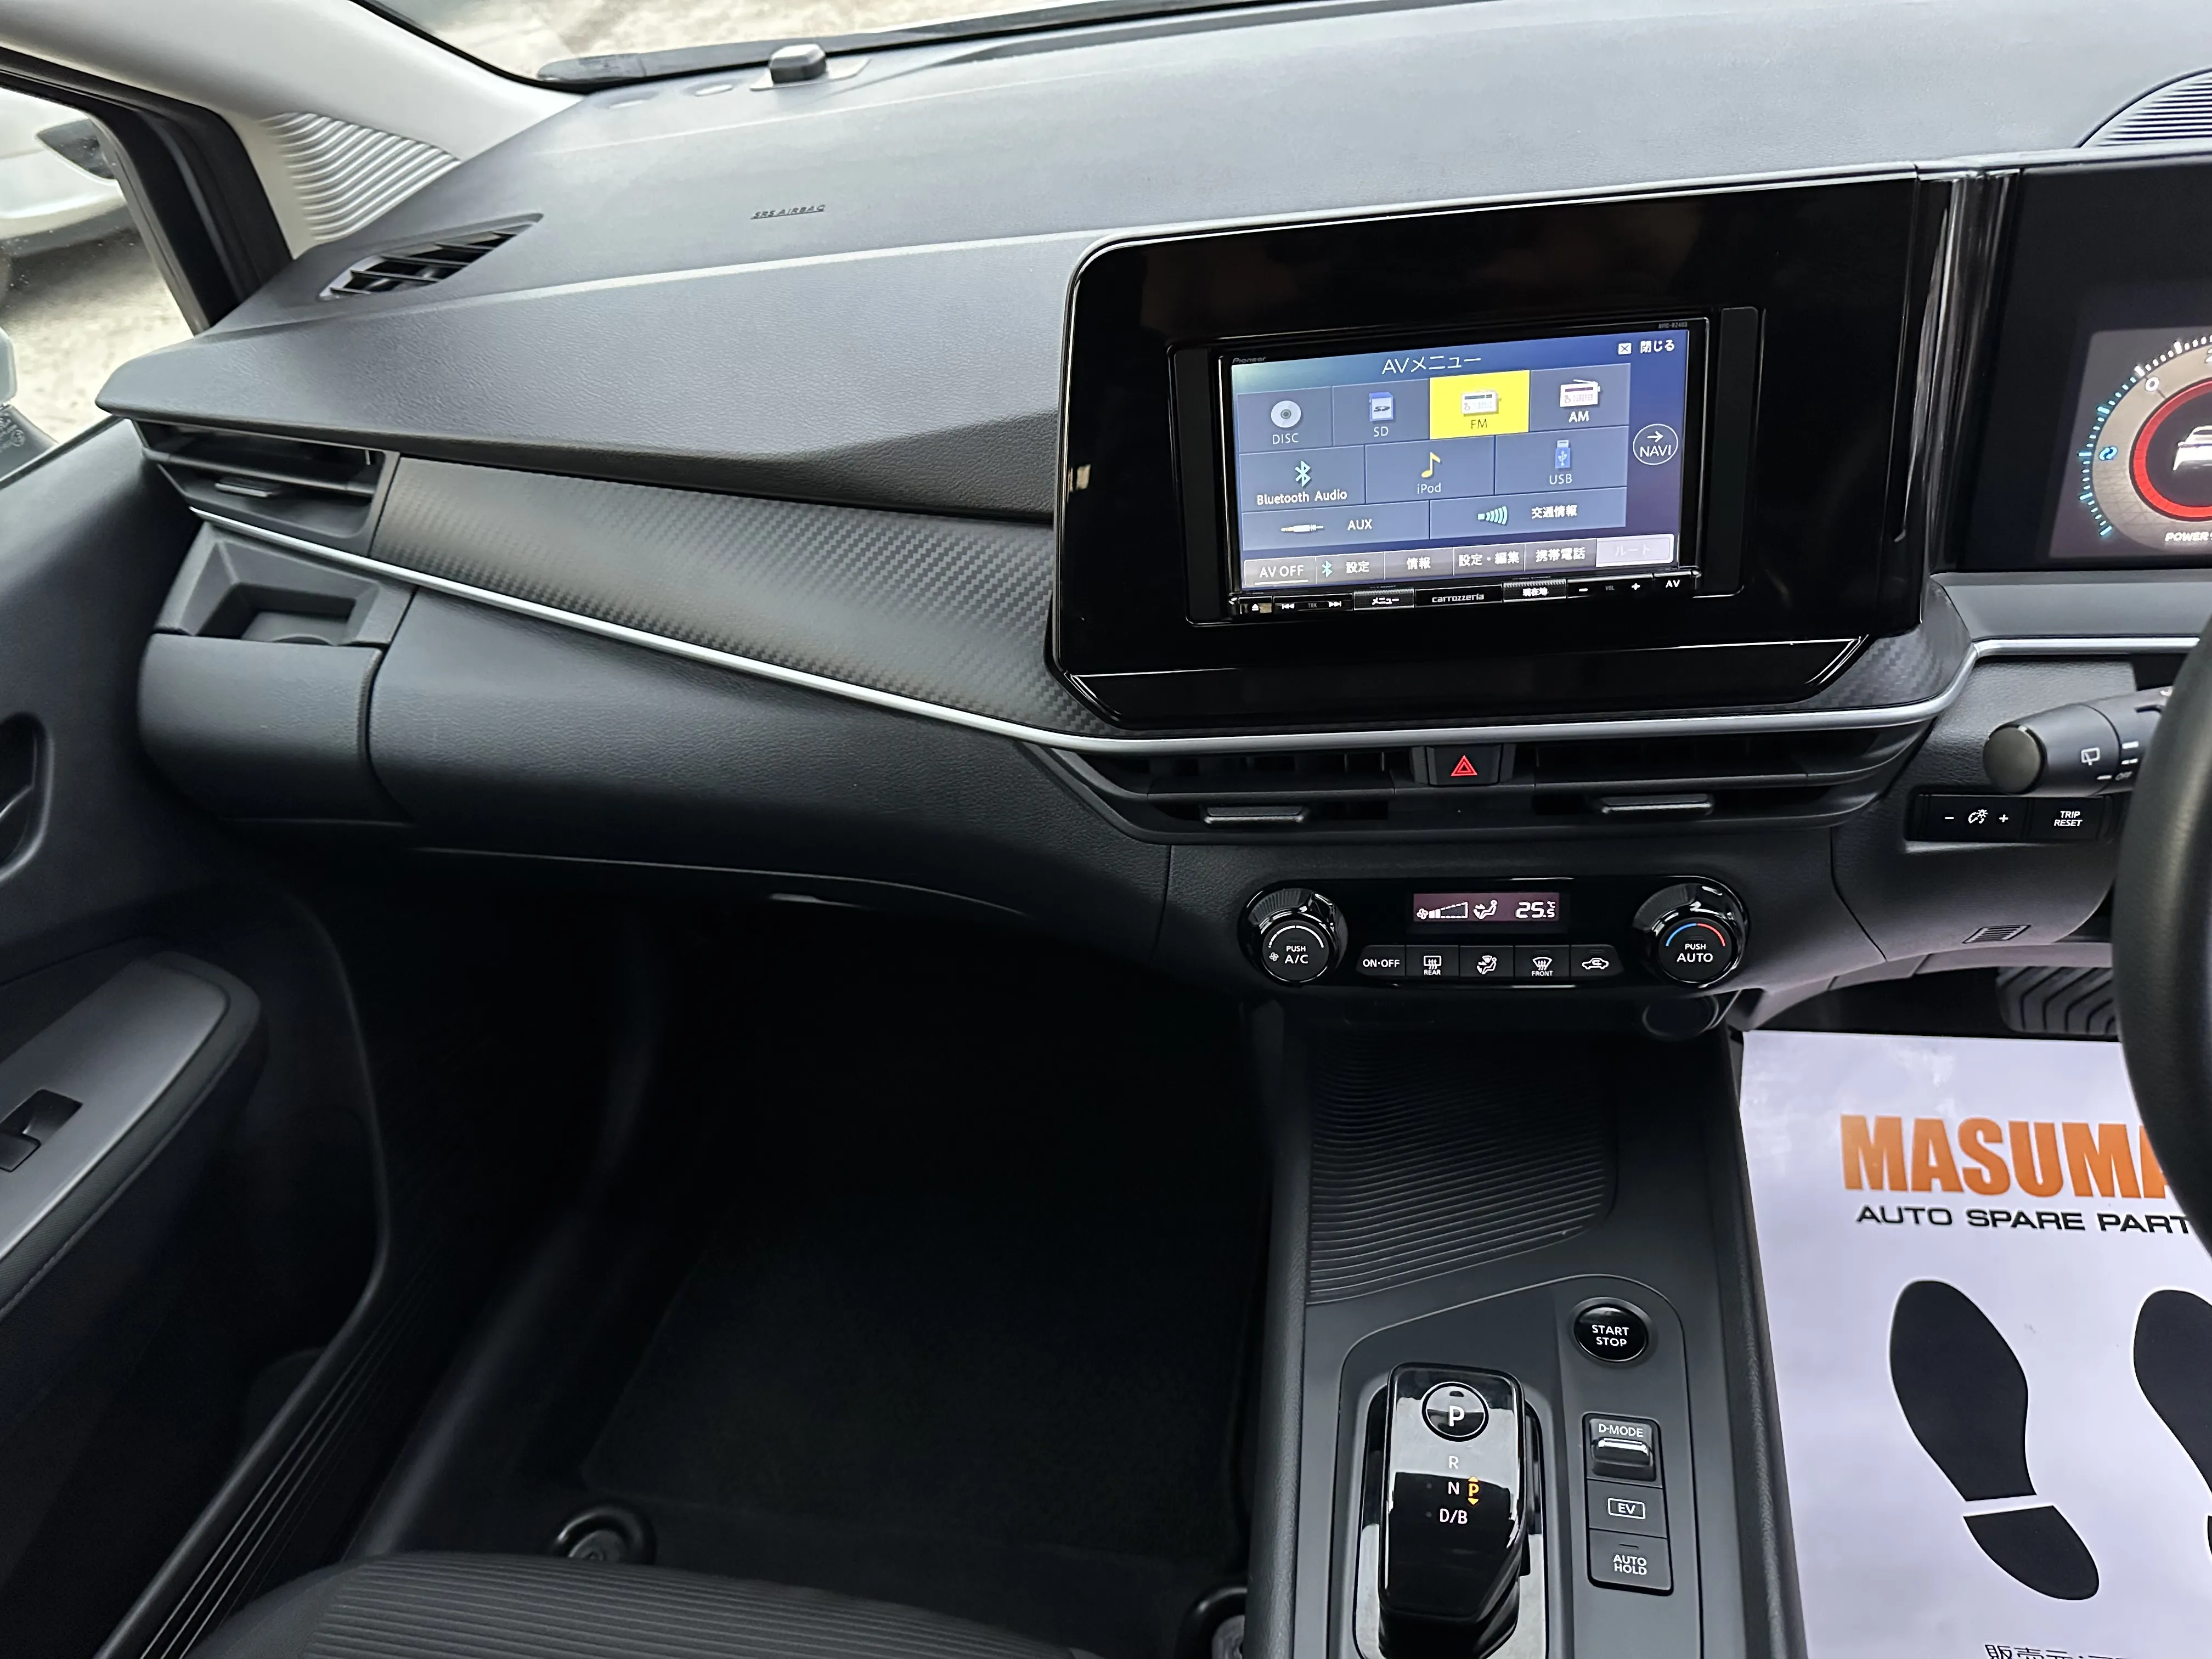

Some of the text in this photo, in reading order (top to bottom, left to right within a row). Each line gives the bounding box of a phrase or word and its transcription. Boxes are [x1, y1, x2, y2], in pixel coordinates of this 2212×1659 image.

[752, 205, 826, 219] SRS AIRBAG
[1640, 339, 1675, 354] 閉じる
[1381, 355, 1481, 375] AVメニュー
[1568, 410, 1590, 423] AM
[1470, 419, 1488, 430] FM
[1373, 426, 1389, 437] SD
[1272, 433, 1299, 445] DISC
[1639, 444, 1672, 458] NAVI
[1549, 474, 1573, 485] USB
[1417, 483, 1442, 495] iPod
[1256, 489, 1348, 506] Bluetooth Audio
[1531, 504, 1578, 520] 交通情報
[1347, 518, 1373, 531] AUX
[2164, 532, 2209, 542] POWER
[1458, 551, 1520, 567] 設定・編集
[1536, 546, 1586, 563] 携帯電話
[1346, 560, 1370, 574] 設定
[1406, 557, 1431, 571] 情報
[1259, 565, 1305, 578] AV OFF
[1666, 579, 1680, 589] AV
[1372, 597, 1400, 606] メニュー
[1432, 593, 1485, 603] carrozzeria
[2059, 810, 2081, 819] TRIP
[1284, 954, 1309, 964] A/C
[1676, 952, 1714, 963] AUTO
[1856, 1205, 1953, 1226] AUTO
[1966, 1209, 2085, 1231] SPARE
[1592, 1324, 1629, 1336] START
[1596, 1336, 1627, 1347] STOP
[1448, 1405, 1465, 1427] P
[1598, 1423, 1644, 1437] D-MODE
[1449, 1455, 1459, 1469] R
[1448, 1482, 1480, 1497] N P
[1618, 1503, 1635, 1514] EV
[1440, 1508, 1468, 1525] D/B
[1613, 1554, 1647, 1566] AUTO
[1614, 1564, 1647, 1575] HOLD
